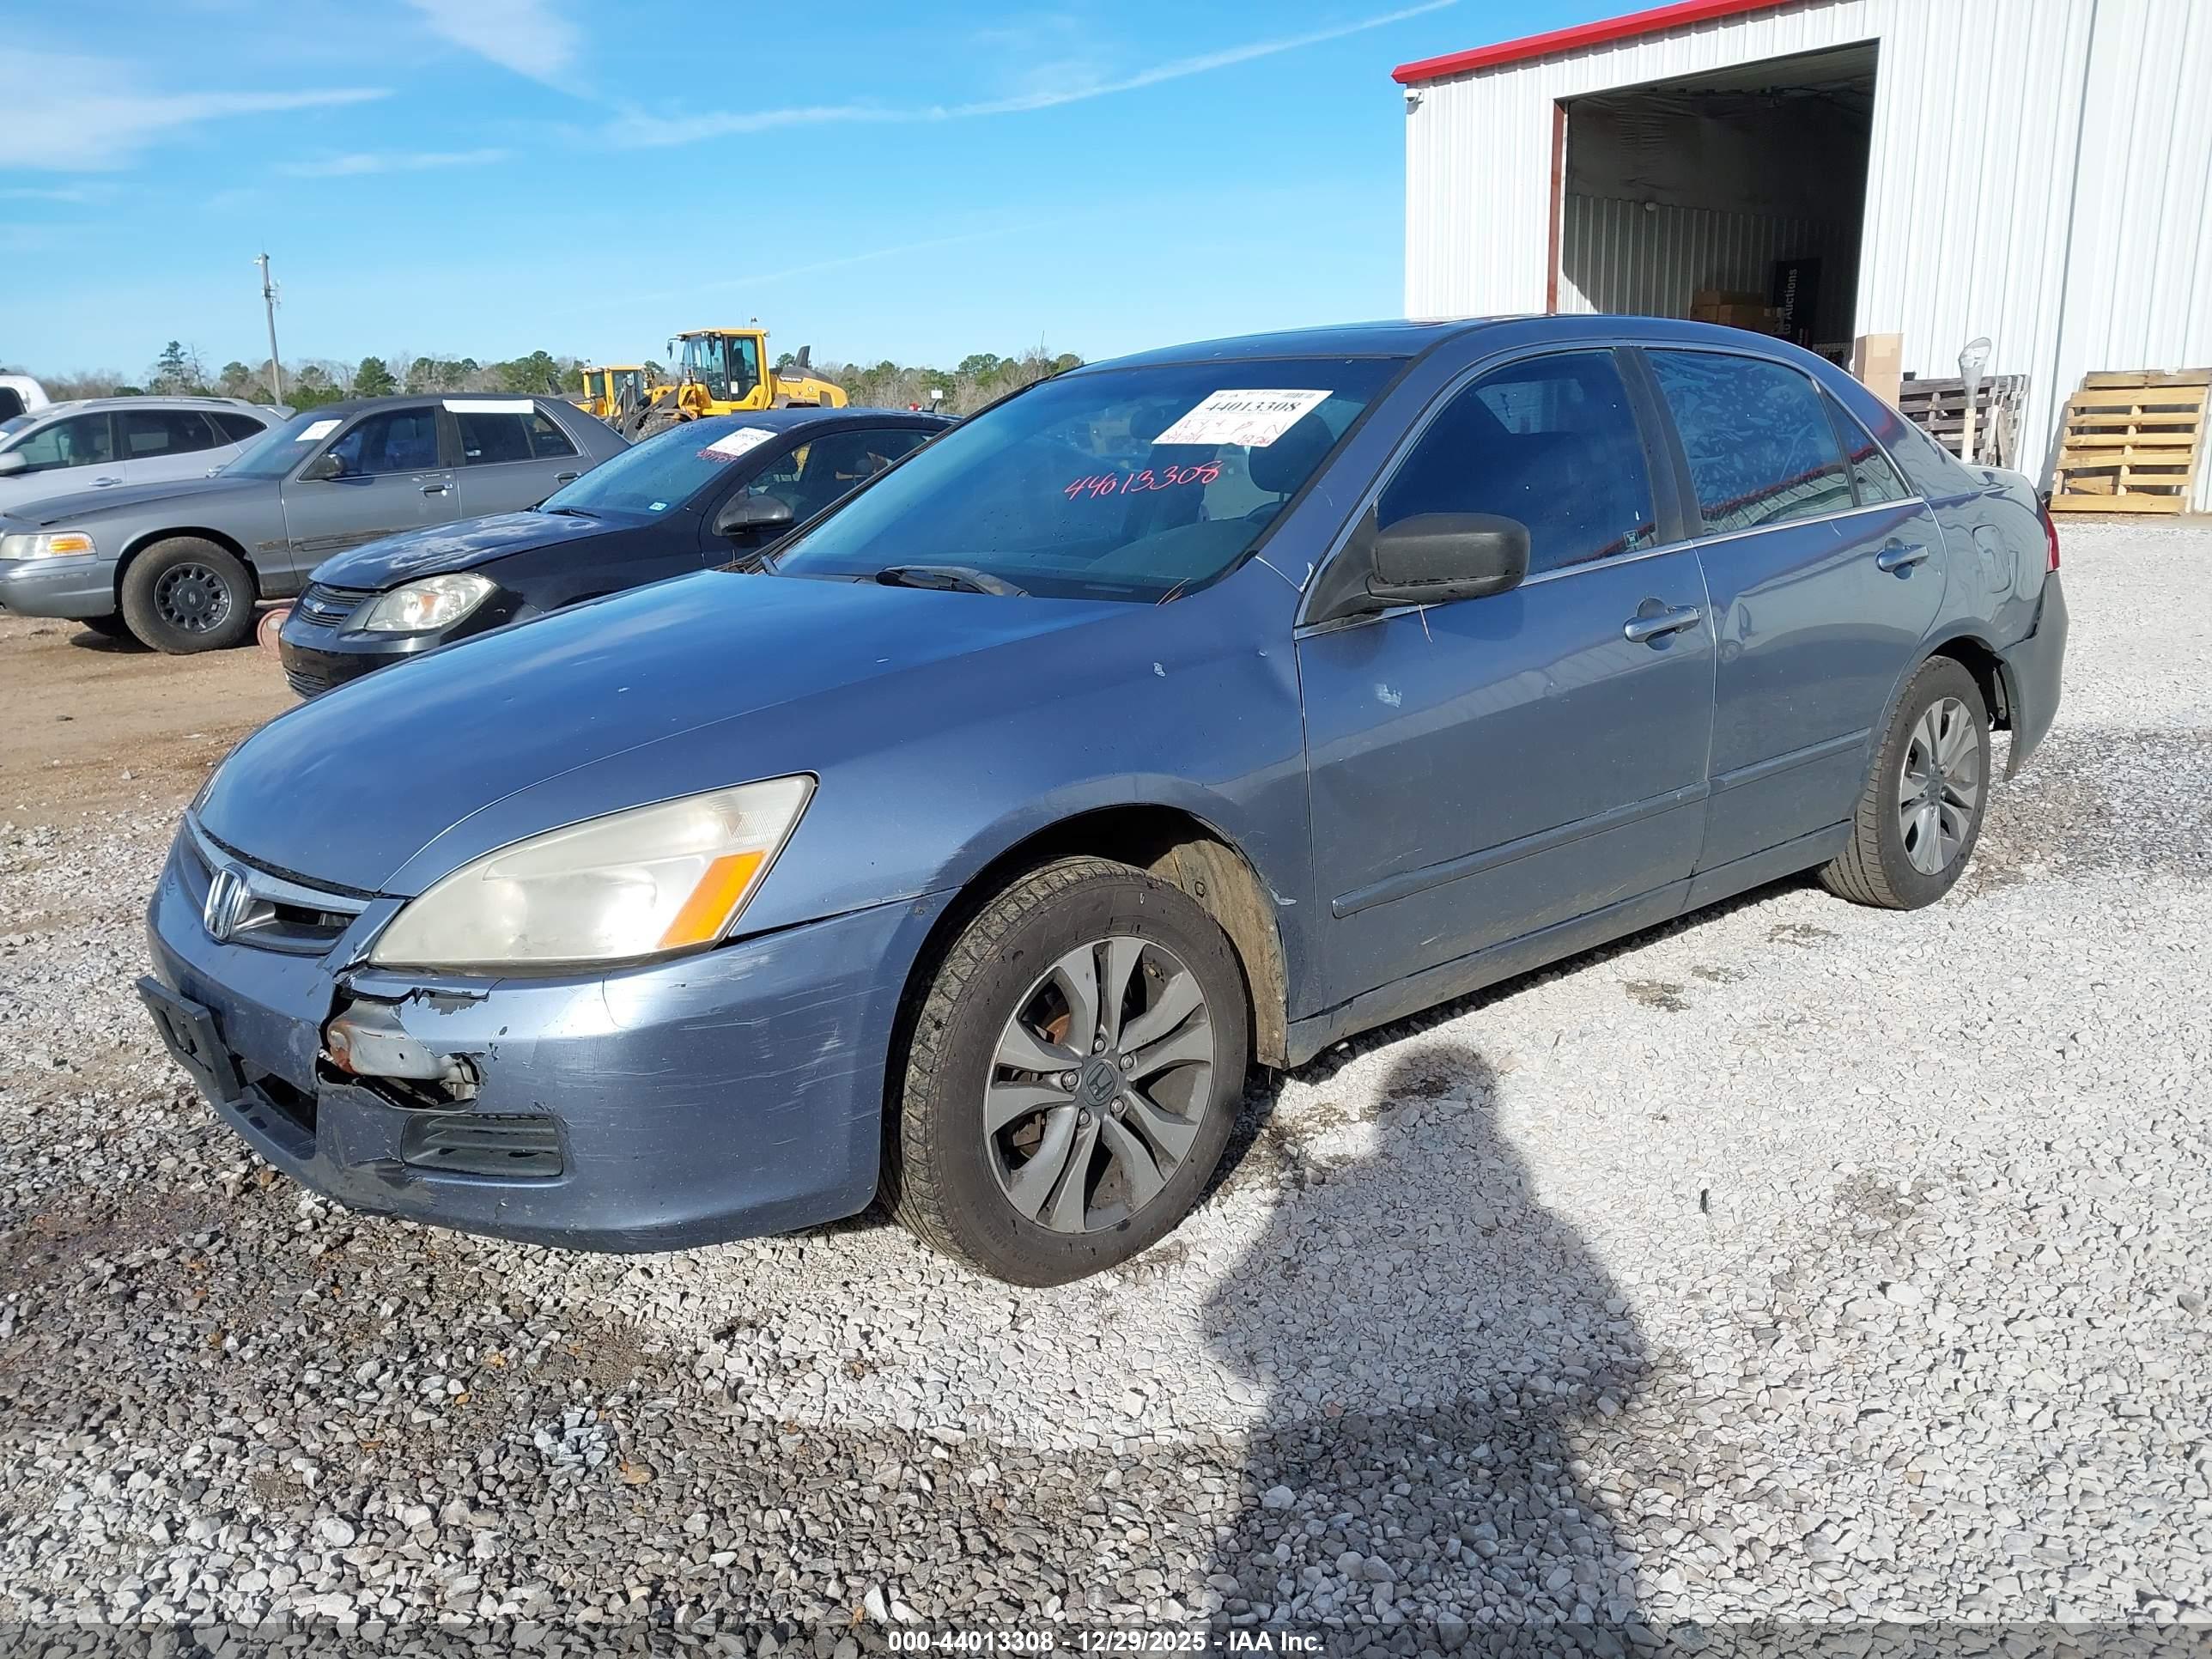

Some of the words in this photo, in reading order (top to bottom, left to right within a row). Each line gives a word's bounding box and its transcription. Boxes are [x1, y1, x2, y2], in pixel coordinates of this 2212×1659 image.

[1785, 268, 1798, 320] Auctions
[1206, 401, 1302, 412] 44013308
[1064, 460, 1225, 500] 44013308
